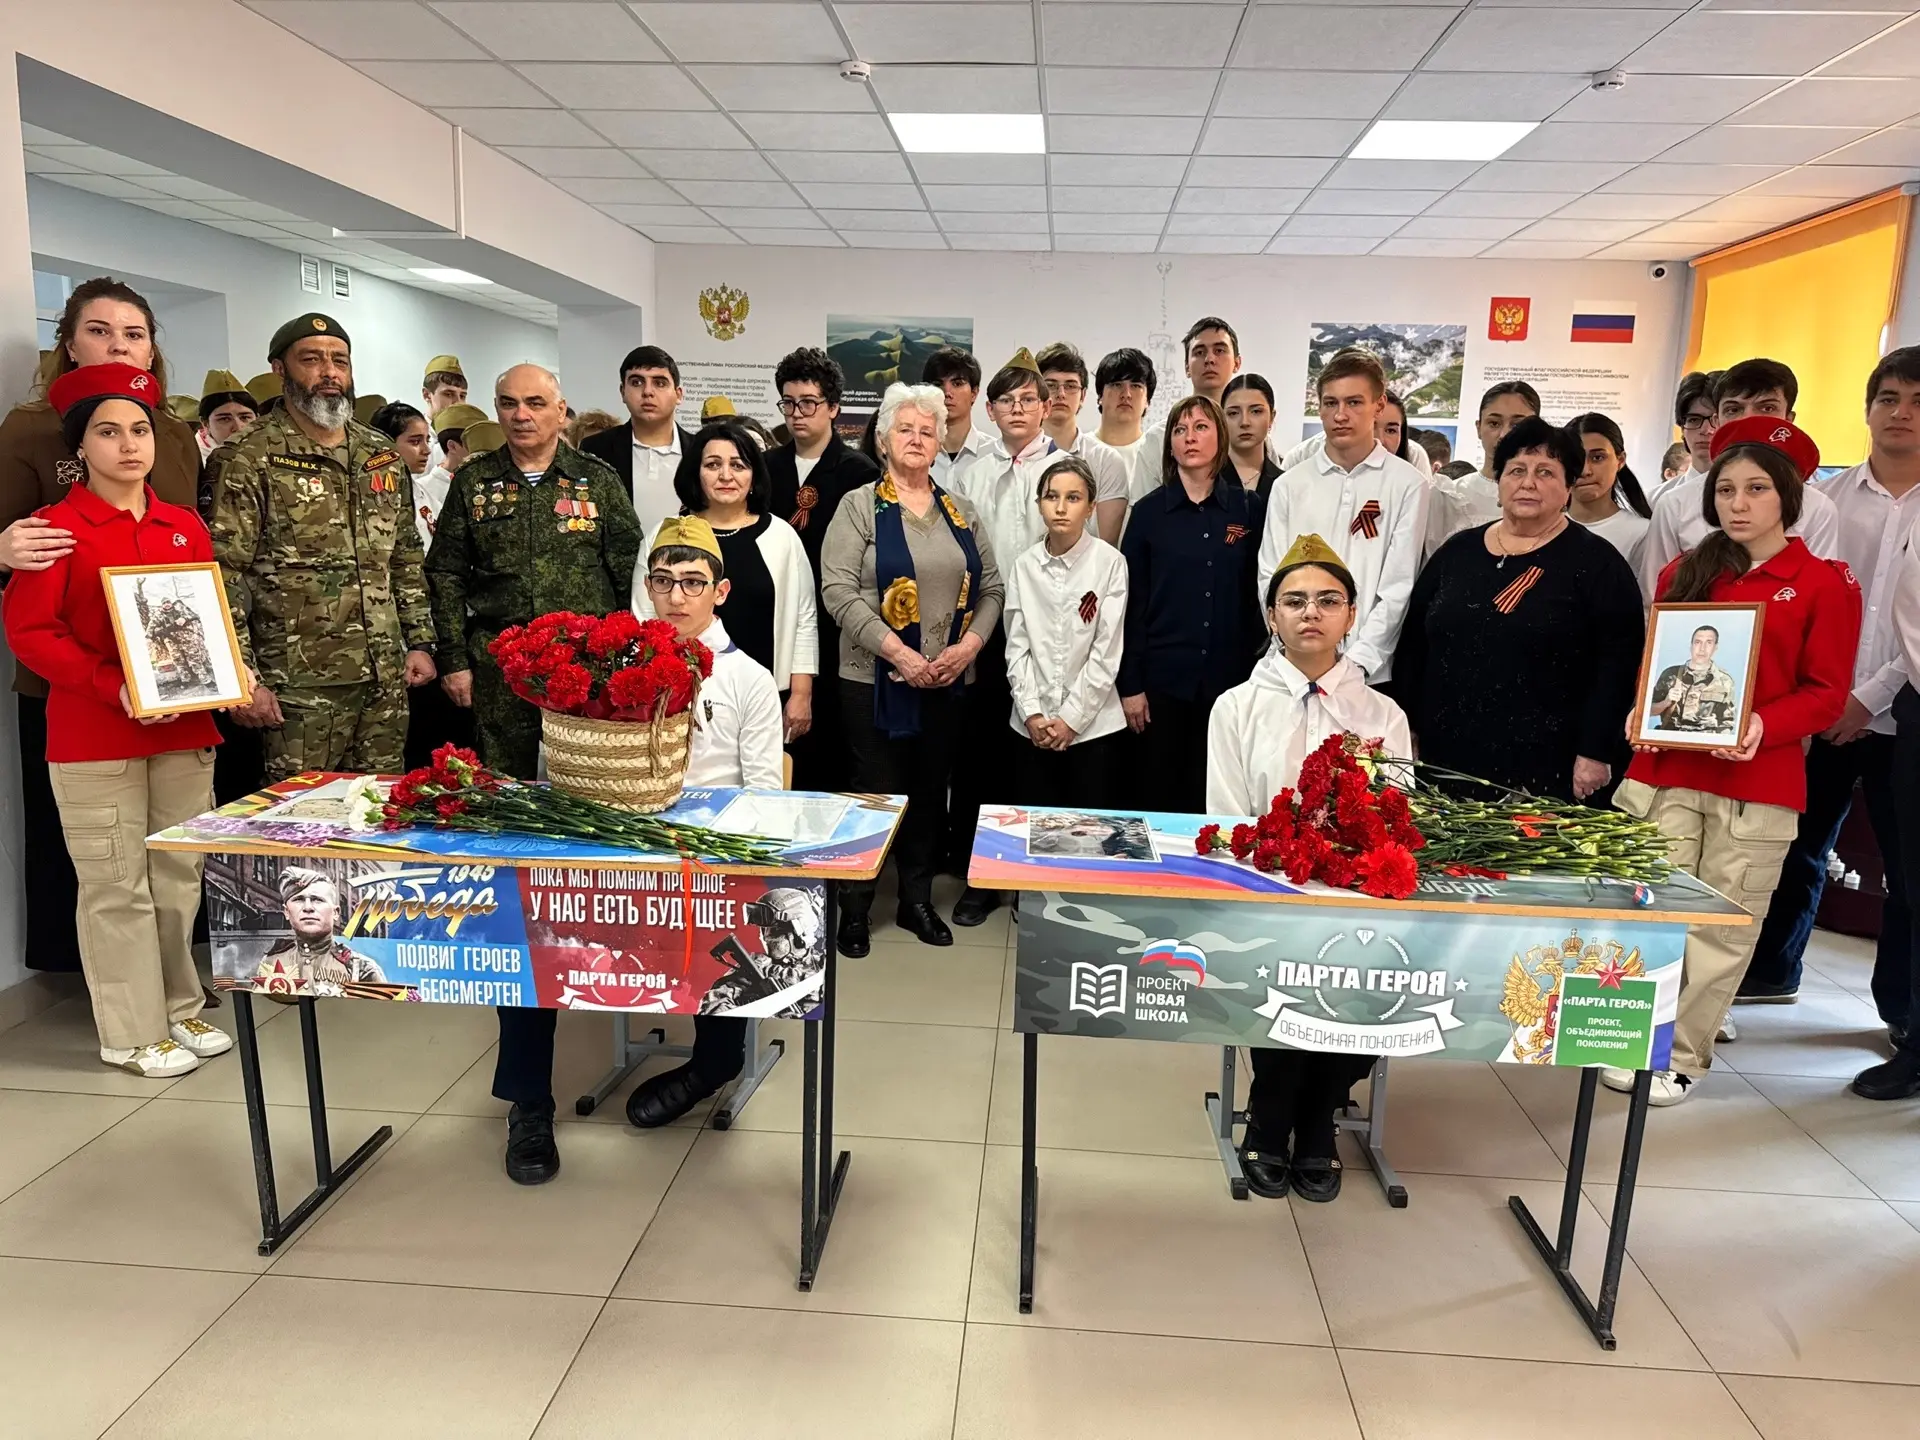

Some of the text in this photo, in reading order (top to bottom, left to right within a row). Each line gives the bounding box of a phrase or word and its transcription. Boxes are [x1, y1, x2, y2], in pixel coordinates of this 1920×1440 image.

[273, 456, 319, 470] ПАЗОВ М.Х.
[446, 864, 496, 884] 1945
[530, 867, 564, 887] ПОКА
[568, 869, 594, 889] МЫ
[598, 870, 658, 892] ПОМНИМ
[1417, 880, 1508, 897] ОБЕДЕ
[342, 867, 499, 941] Победа
[530, 891, 543, 922] У
[549, 892, 586, 923] НАС
[593, 894, 640, 925] ЕСТЬ
[396, 943, 521, 974] ПОДВИГ ГЕРОЕВ
[568, 970, 667, 989] ПАРТА ГЕРОЯ
[1136, 976, 1191, 991] ПРОЕКТ
[1277, 960, 1447, 997] ПАРТА ГЕРОЯ
[420, 978, 522, 1007] БЕССМЕРТЕН
[1136, 992, 1185, 1007] НОВАЯ
[1563, 996, 1652, 1010] «ПАРТА ГЕРОЯ»
[1135, 1008, 1189, 1024] ШКОЛА
[1587, 1017, 1622, 1028] ПРОЕКТ,
[1566, 1027, 1642, 1039] ОБЪЕДИНЯЮЩИЙ
[1576, 1039, 1628, 1050] ПОКОЛЕНИЯ
